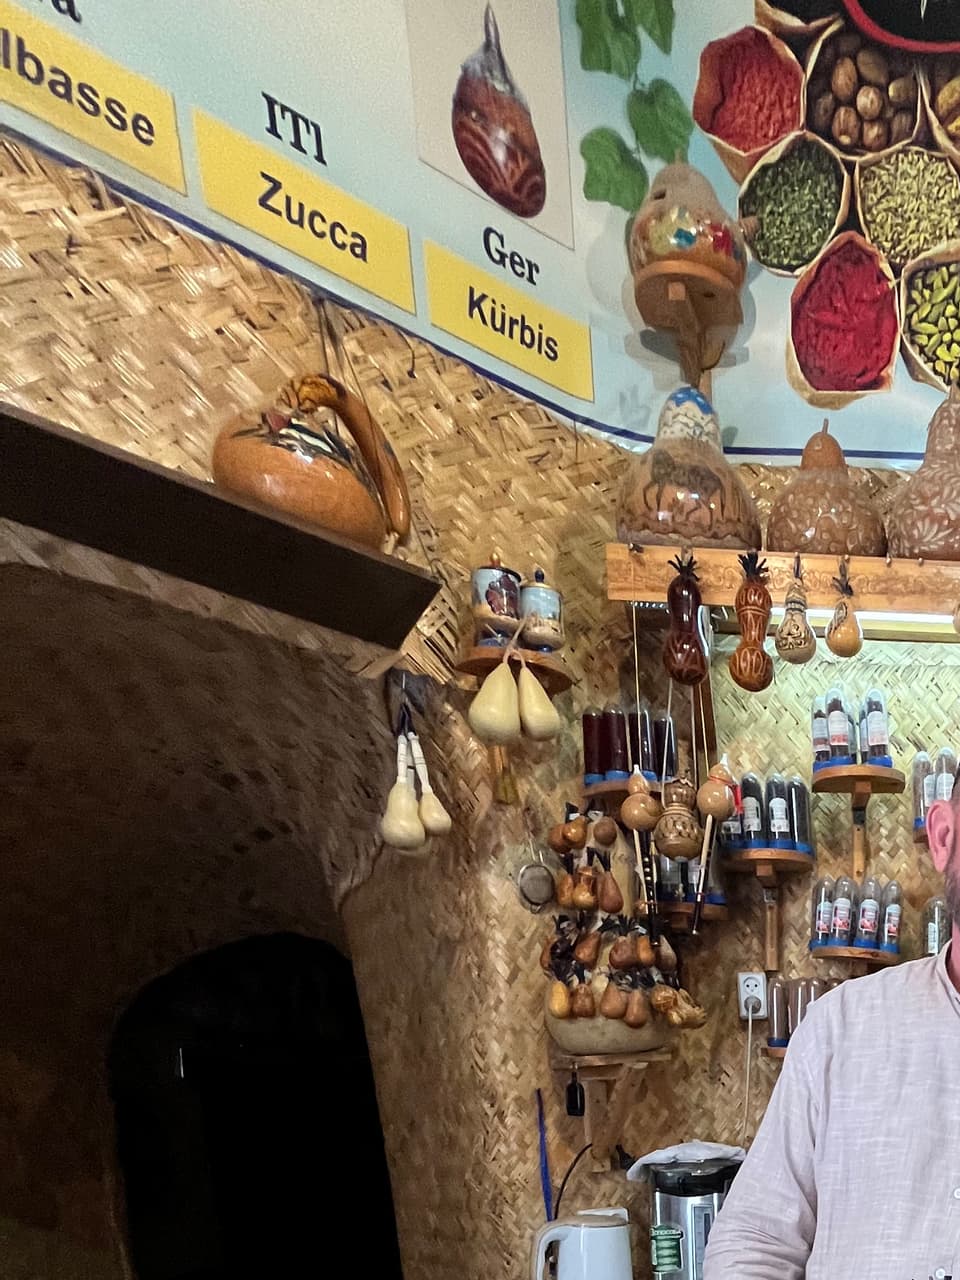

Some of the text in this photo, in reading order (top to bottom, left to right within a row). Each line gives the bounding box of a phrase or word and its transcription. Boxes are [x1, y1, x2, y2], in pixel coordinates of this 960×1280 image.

[258, 171, 369, 263] Zucca
[483, 226, 541, 286] Ger
[467, 286, 559, 362] Kürbis
